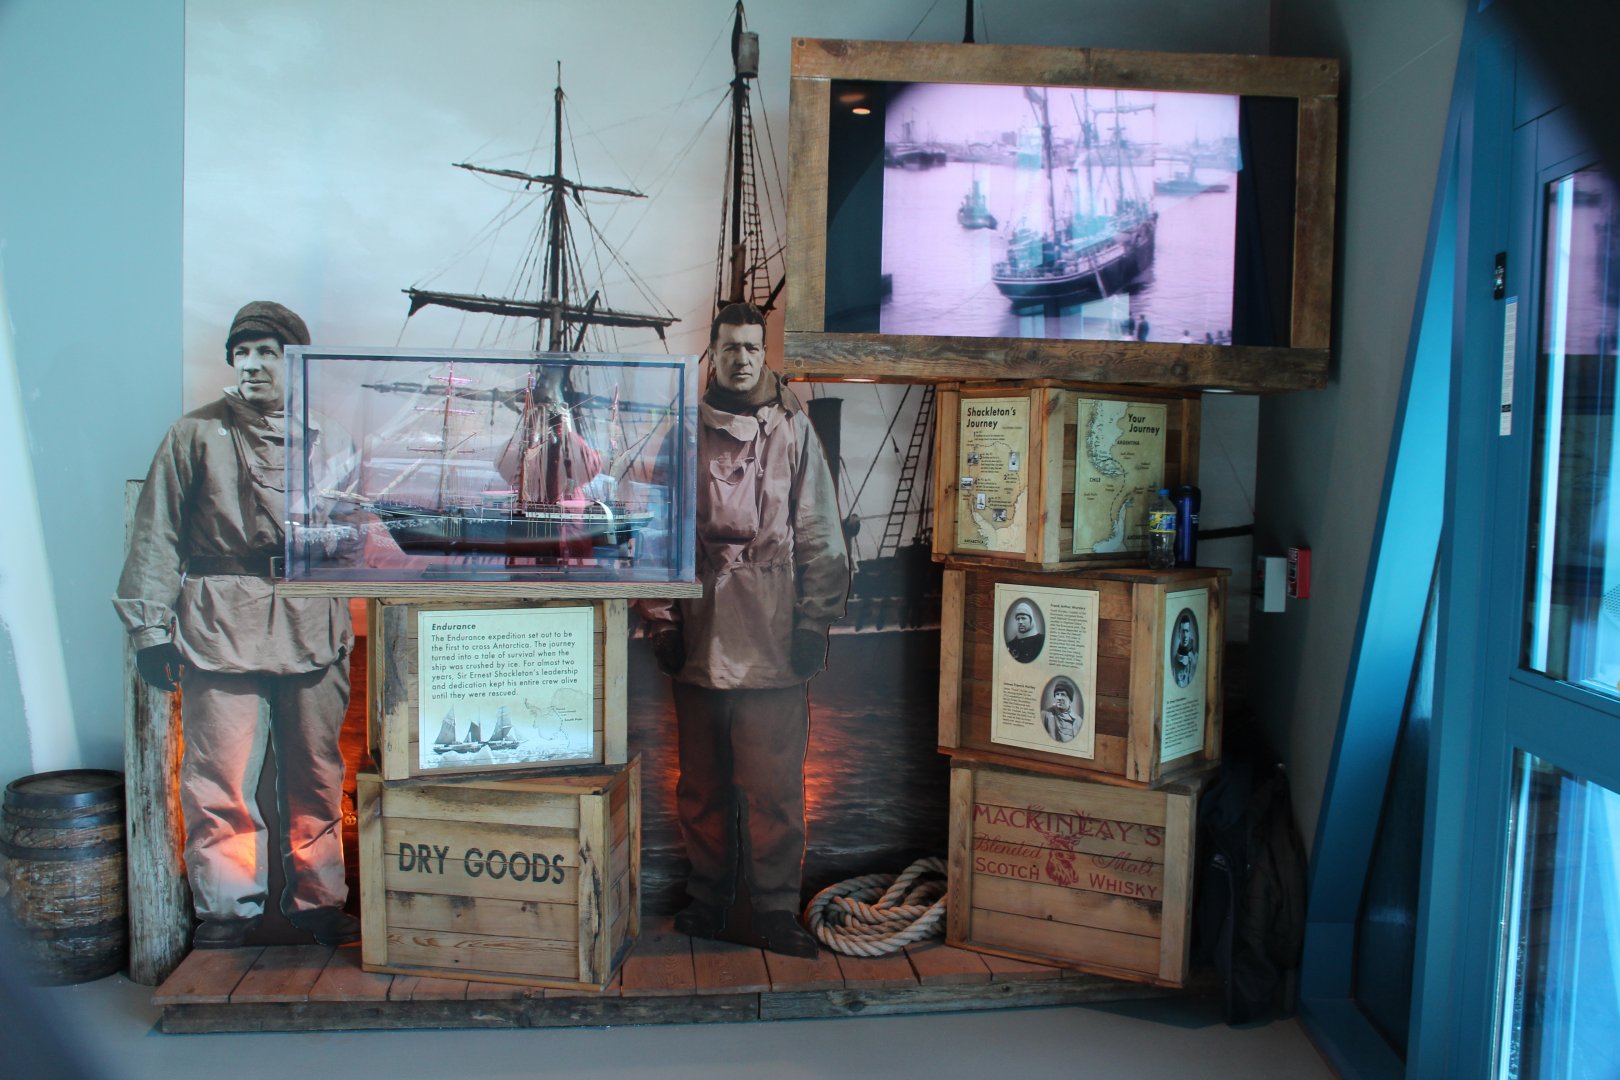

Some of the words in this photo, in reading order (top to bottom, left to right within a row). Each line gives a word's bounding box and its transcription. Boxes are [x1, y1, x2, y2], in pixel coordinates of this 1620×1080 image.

[967, 406, 1016, 417] Shackleton's
[1128, 413, 1146, 423] Your
[966, 419, 998, 430] Journey
[1129, 423, 1160, 436] Journey
[432, 623, 476, 631] Endurance
[488, 632, 526, 641] expedition
[549, 640, 575, 648] journey
[432, 663, 446, 672] ship
[496, 661, 505, 669] by
[432, 674, 454, 682] years,
[494, 669, 539, 678] Shackleton's
[542, 668, 578, 677] leadership
[448, 681, 487, 689] dedication
[489, 680, 505, 688] kept
[519, 678, 539, 686] entire
[450, 692, 465, 700] they
[488, 689, 518, 697] rescued.
[973, 804, 1162, 847] MACKINLAY'S
[975, 832, 1043, 859] Blended
[1091, 850, 1155, 877] Malt
[399, 842, 450, 875] DRY
[464, 847, 566, 885] GOODS
[975, 857, 1040, 880] SCOTCH
[1089, 873, 1157, 897] WHISKY
